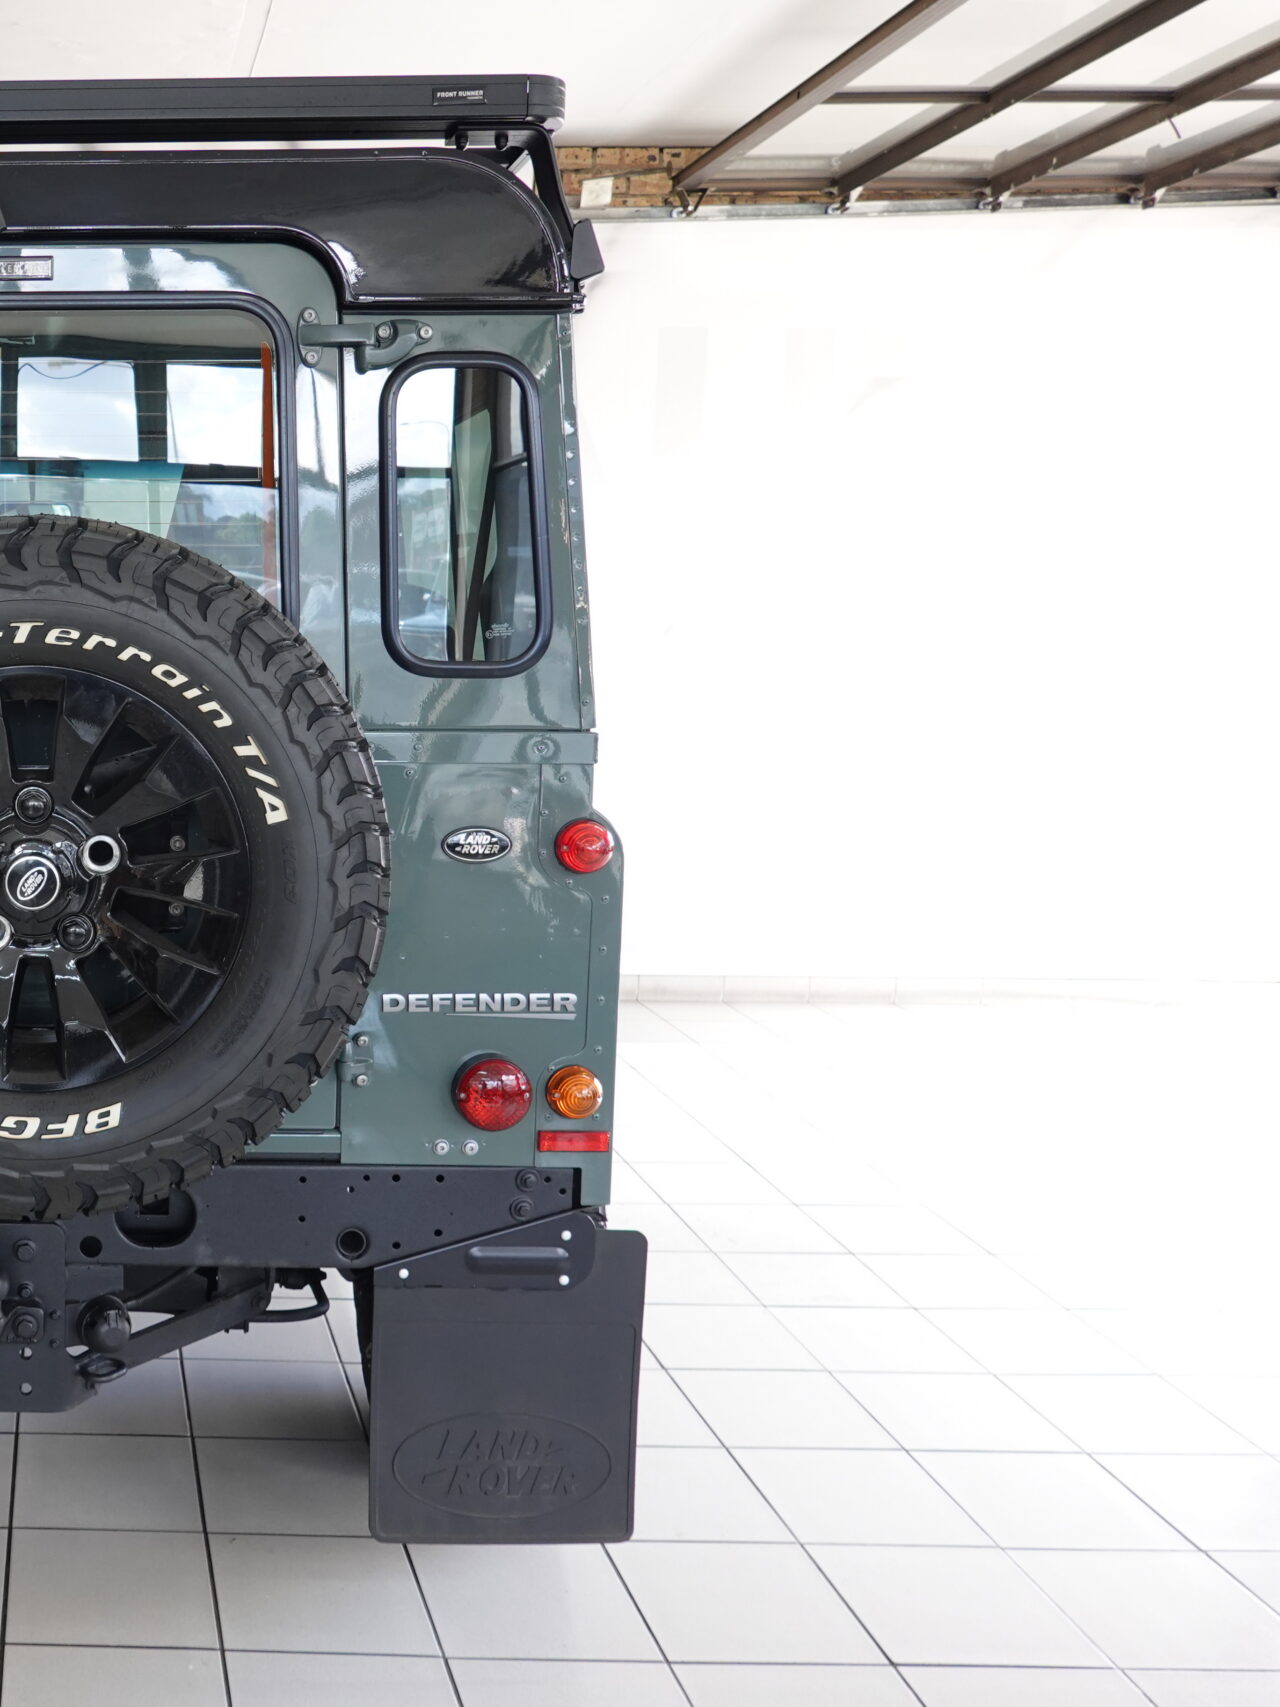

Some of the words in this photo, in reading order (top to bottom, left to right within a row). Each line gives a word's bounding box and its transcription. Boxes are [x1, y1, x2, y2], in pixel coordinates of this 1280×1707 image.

[232, 735, 290, 825] T/A
[459, 835, 491, 844] LAND
[461, 844, 500, 854] ROVER
[382, 992, 578, 1013] DEFENDER
